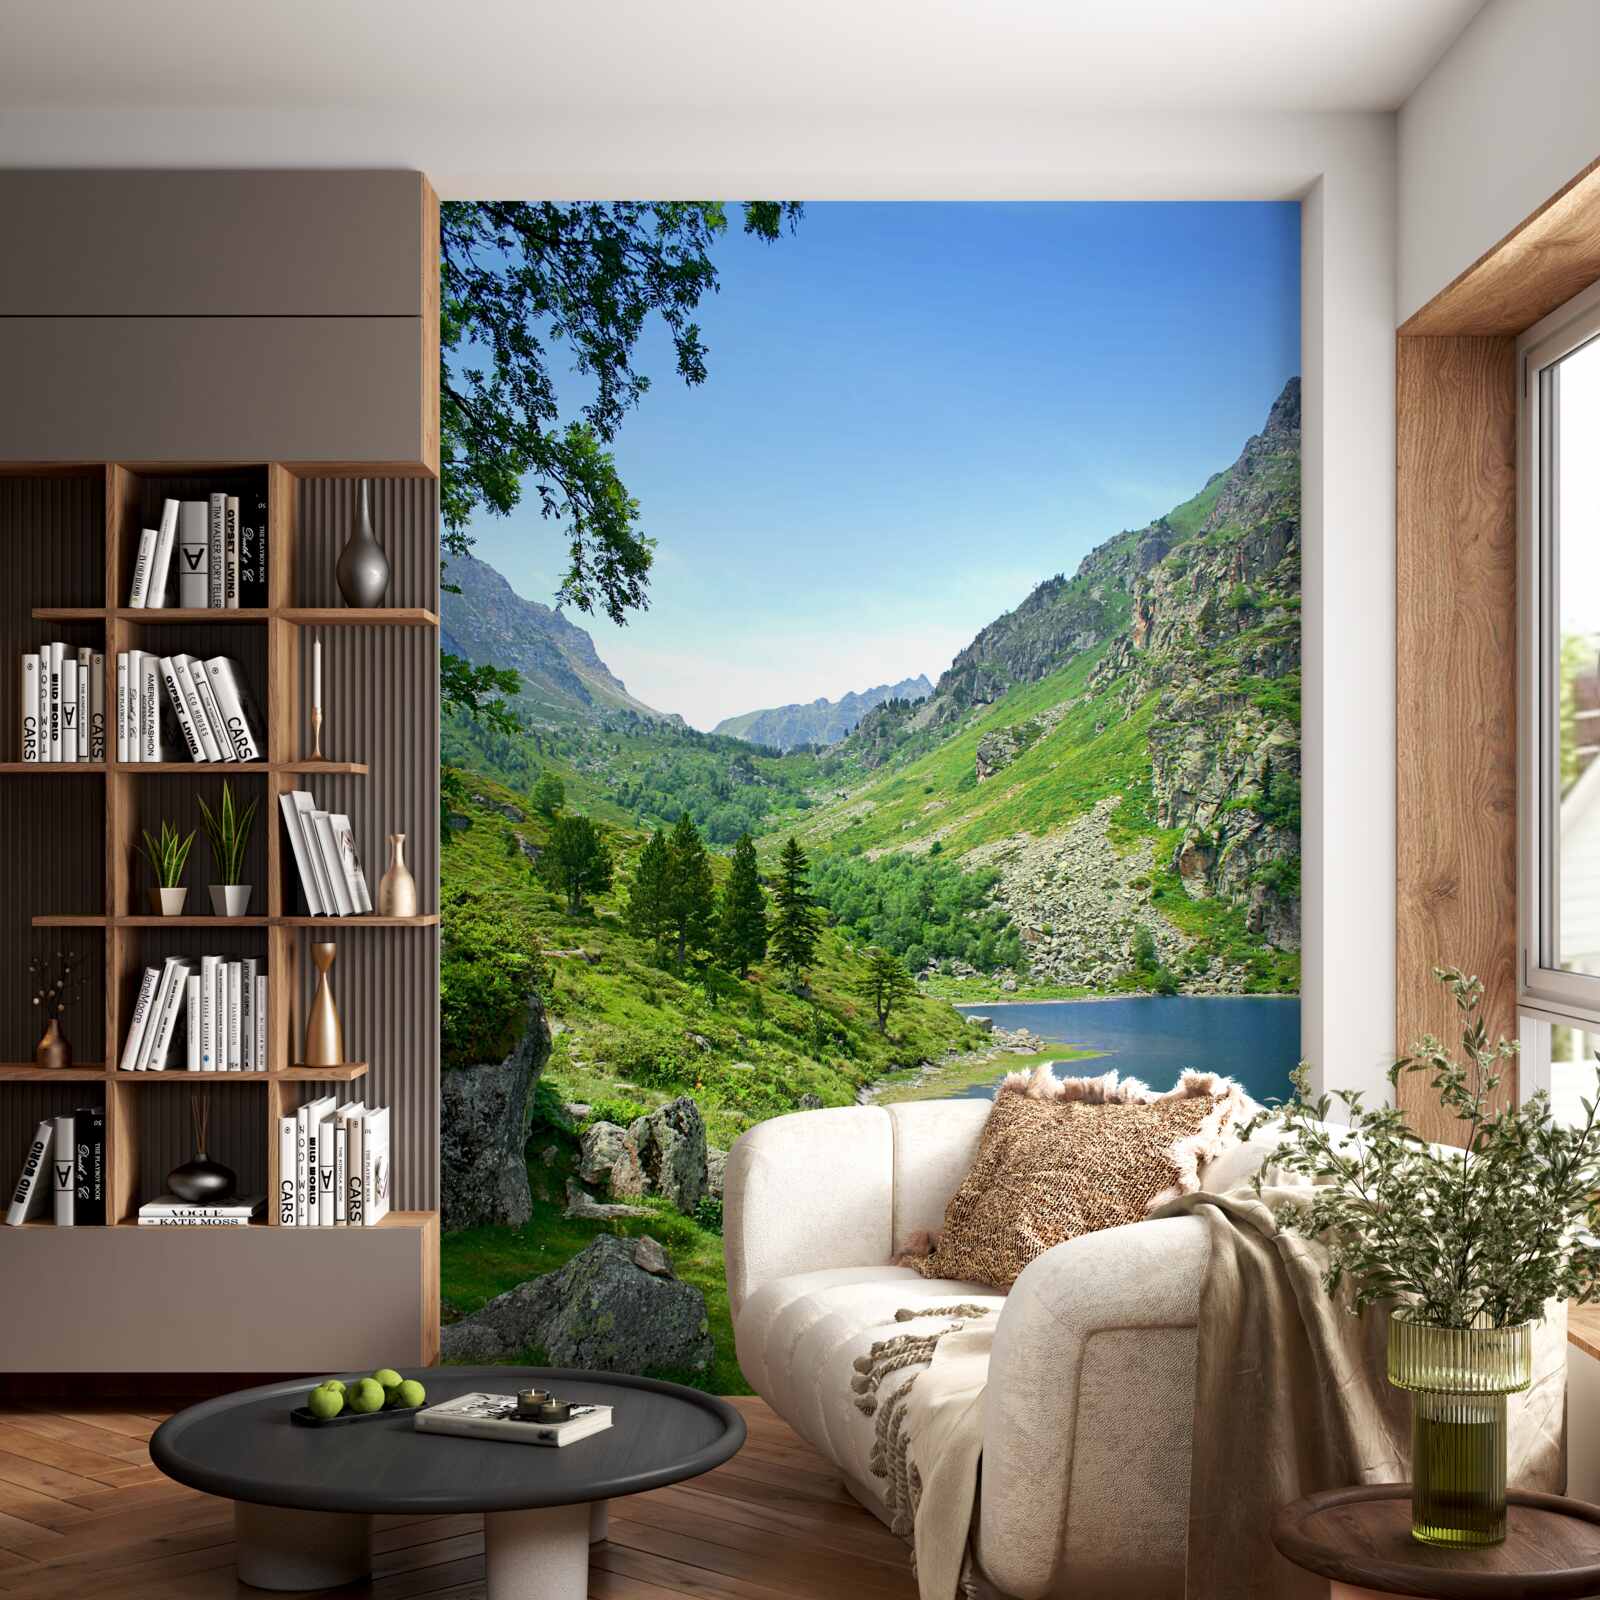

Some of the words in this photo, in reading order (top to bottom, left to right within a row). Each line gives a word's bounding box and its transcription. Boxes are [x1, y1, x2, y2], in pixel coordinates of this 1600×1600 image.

[213, 506, 222, 519] TIM
[213, 521, 222, 554] WALKER
[182, 548, 205, 570] A
[213, 556, 222, 581] STORY
[227, 561, 235, 599] LIVING
[51, 673, 59, 700] WILD
[147, 673, 155, 718] AMERICAN
[51, 703, 59, 741] WORLD
[63, 706, 75, 726] A
[166, 675, 185, 715] GYPSET
[182, 721, 199, 755] LIVING
[187, 692, 198, 706] ECO
[194, 710, 209, 737] HOUSES
[23, 716, 36, 760] CARS
[92, 713, 104, 759] CARS
[147, 719, 155, 757] FASHION
[227, 716, 252, 760] CARS
[14, 1178, 31, 1204] WILD
[23, 1141, 45, 1177] WORLD
[56, 1165, 72, 1188] A
[321, 1169, 333, 1190] A
[171, 1209, 224, 1217] VOGUE
[281, 1180, 294, 1224] CARS
[350, 1176, 362, 1222] CARS
[160, 1218, 198, 1226] KATE
[200, 1218, 239, 1226] MOSS
